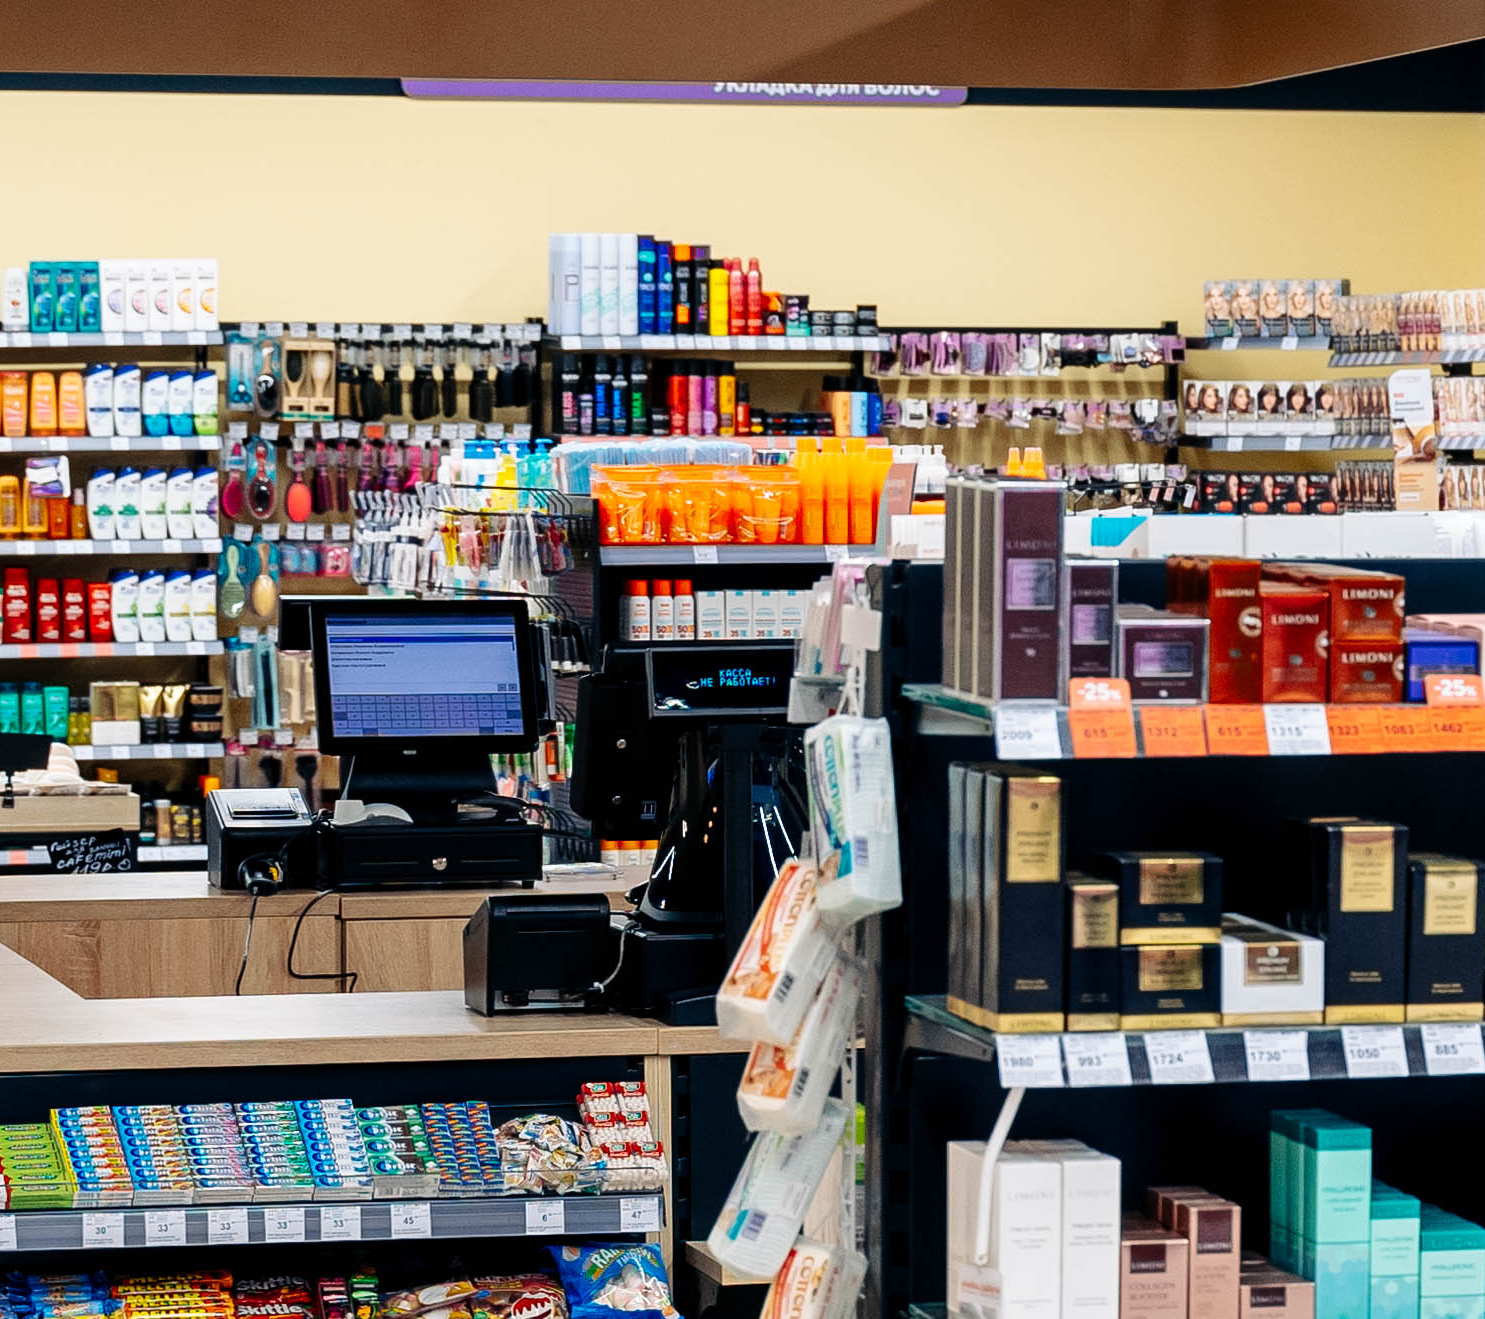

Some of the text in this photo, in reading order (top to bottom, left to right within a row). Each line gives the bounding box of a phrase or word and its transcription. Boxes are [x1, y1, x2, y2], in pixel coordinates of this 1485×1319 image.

[1343, 588, 1395, 600] LIMONI
[1342, 651, 1394, 663] LIMONI
[719, 669, 751, 677] КАССА
[700, 677, 776, 687] НЕ РАБОТАЕТ!
